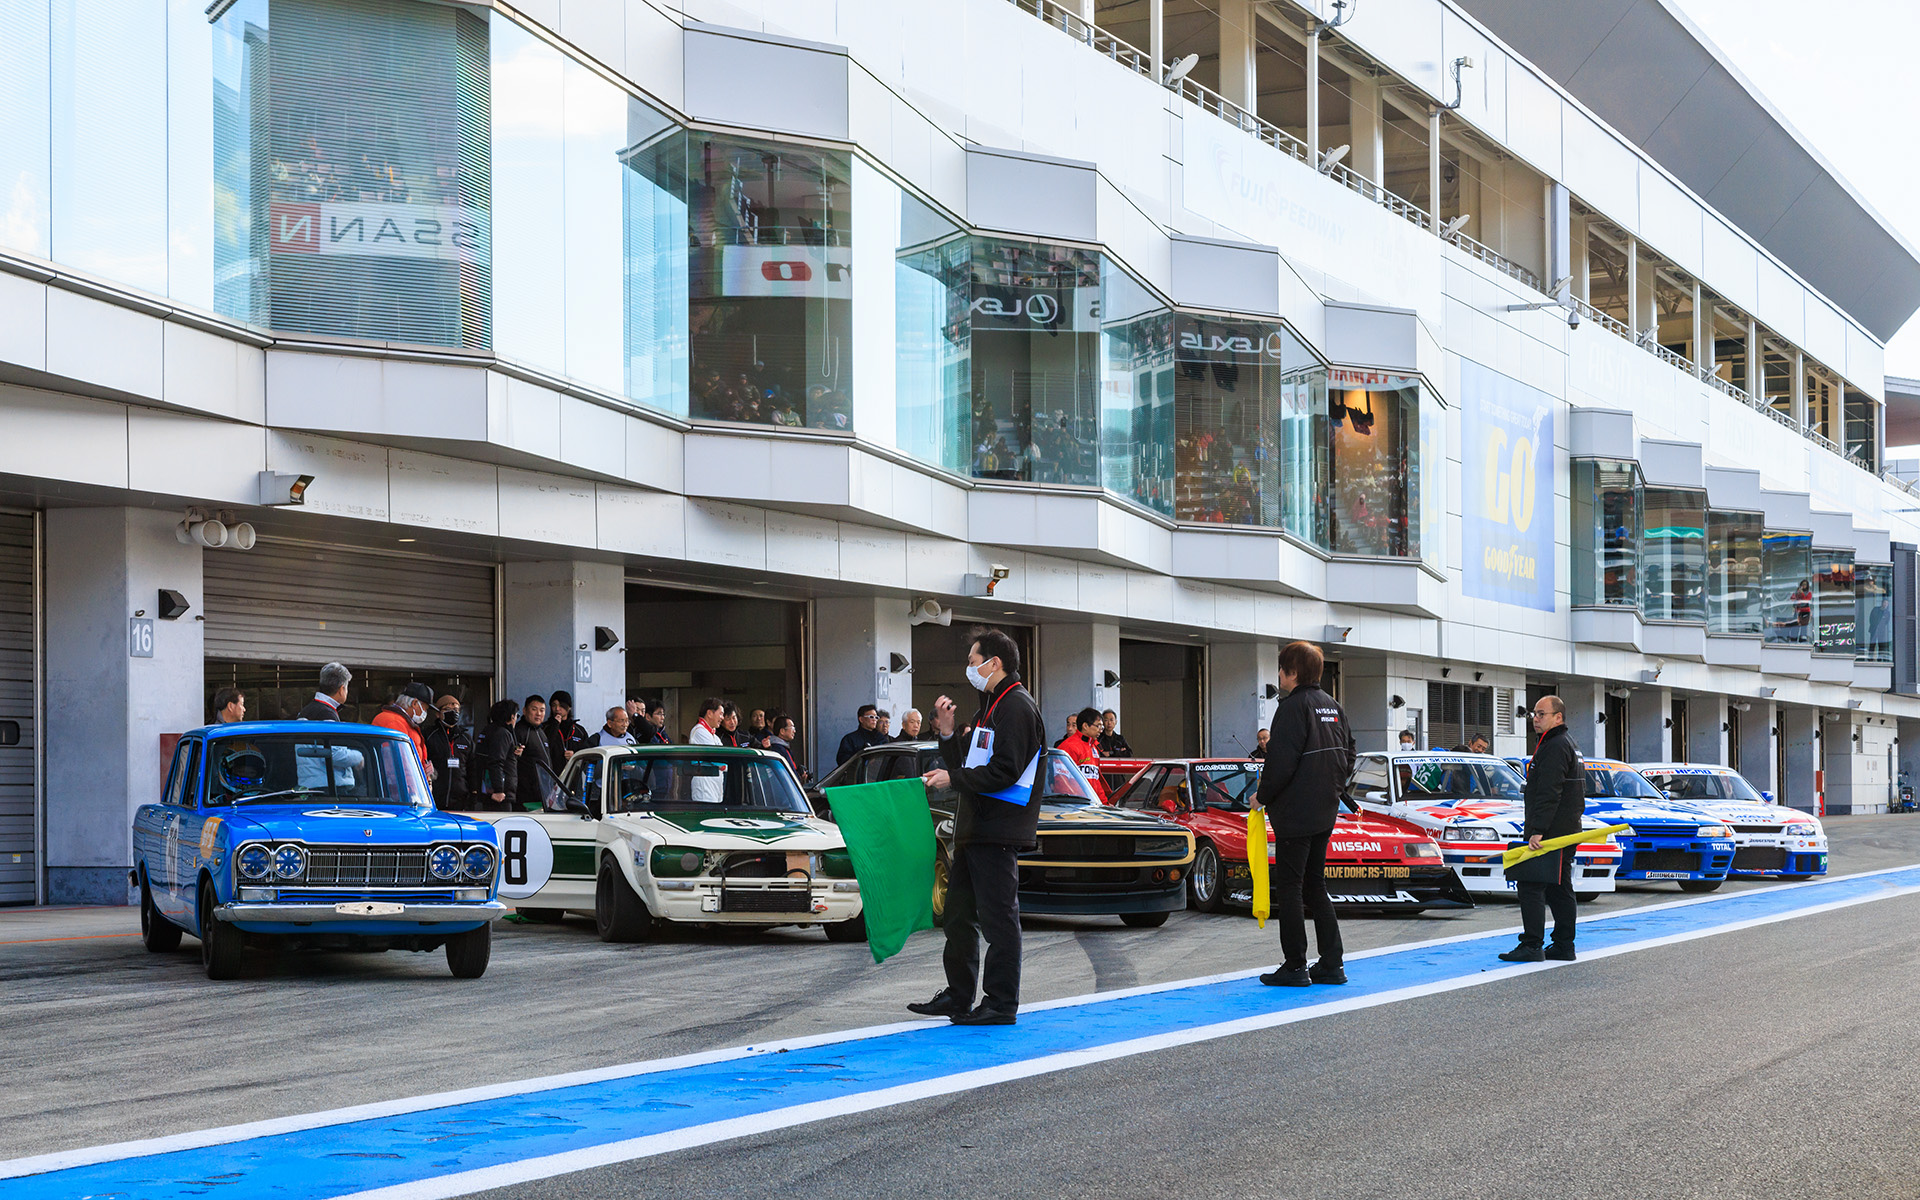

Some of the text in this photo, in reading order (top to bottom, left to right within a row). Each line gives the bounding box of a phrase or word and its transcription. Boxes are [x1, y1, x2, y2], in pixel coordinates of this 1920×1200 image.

[1230, 171, 1264, 205] FUJI
[1485, 426, 1536, 533] GO
[1484, 544, 1535, 582] GOODYEAR
[133, 623, 151, 652] 16
[578, 655, 591, 679] 15
[878, 676, 888, 696] 14
[1425, 828, 1443, 839] TOMY
[504, 830, 528, 885] 8
[1331, 841, 1382, 852] NISSAN
[1711, 843, 1732, 851] TOTAL
[1344, 866, 1367, 878] DOHC
[1368, 866, 1410, 878] RS-TURBO
